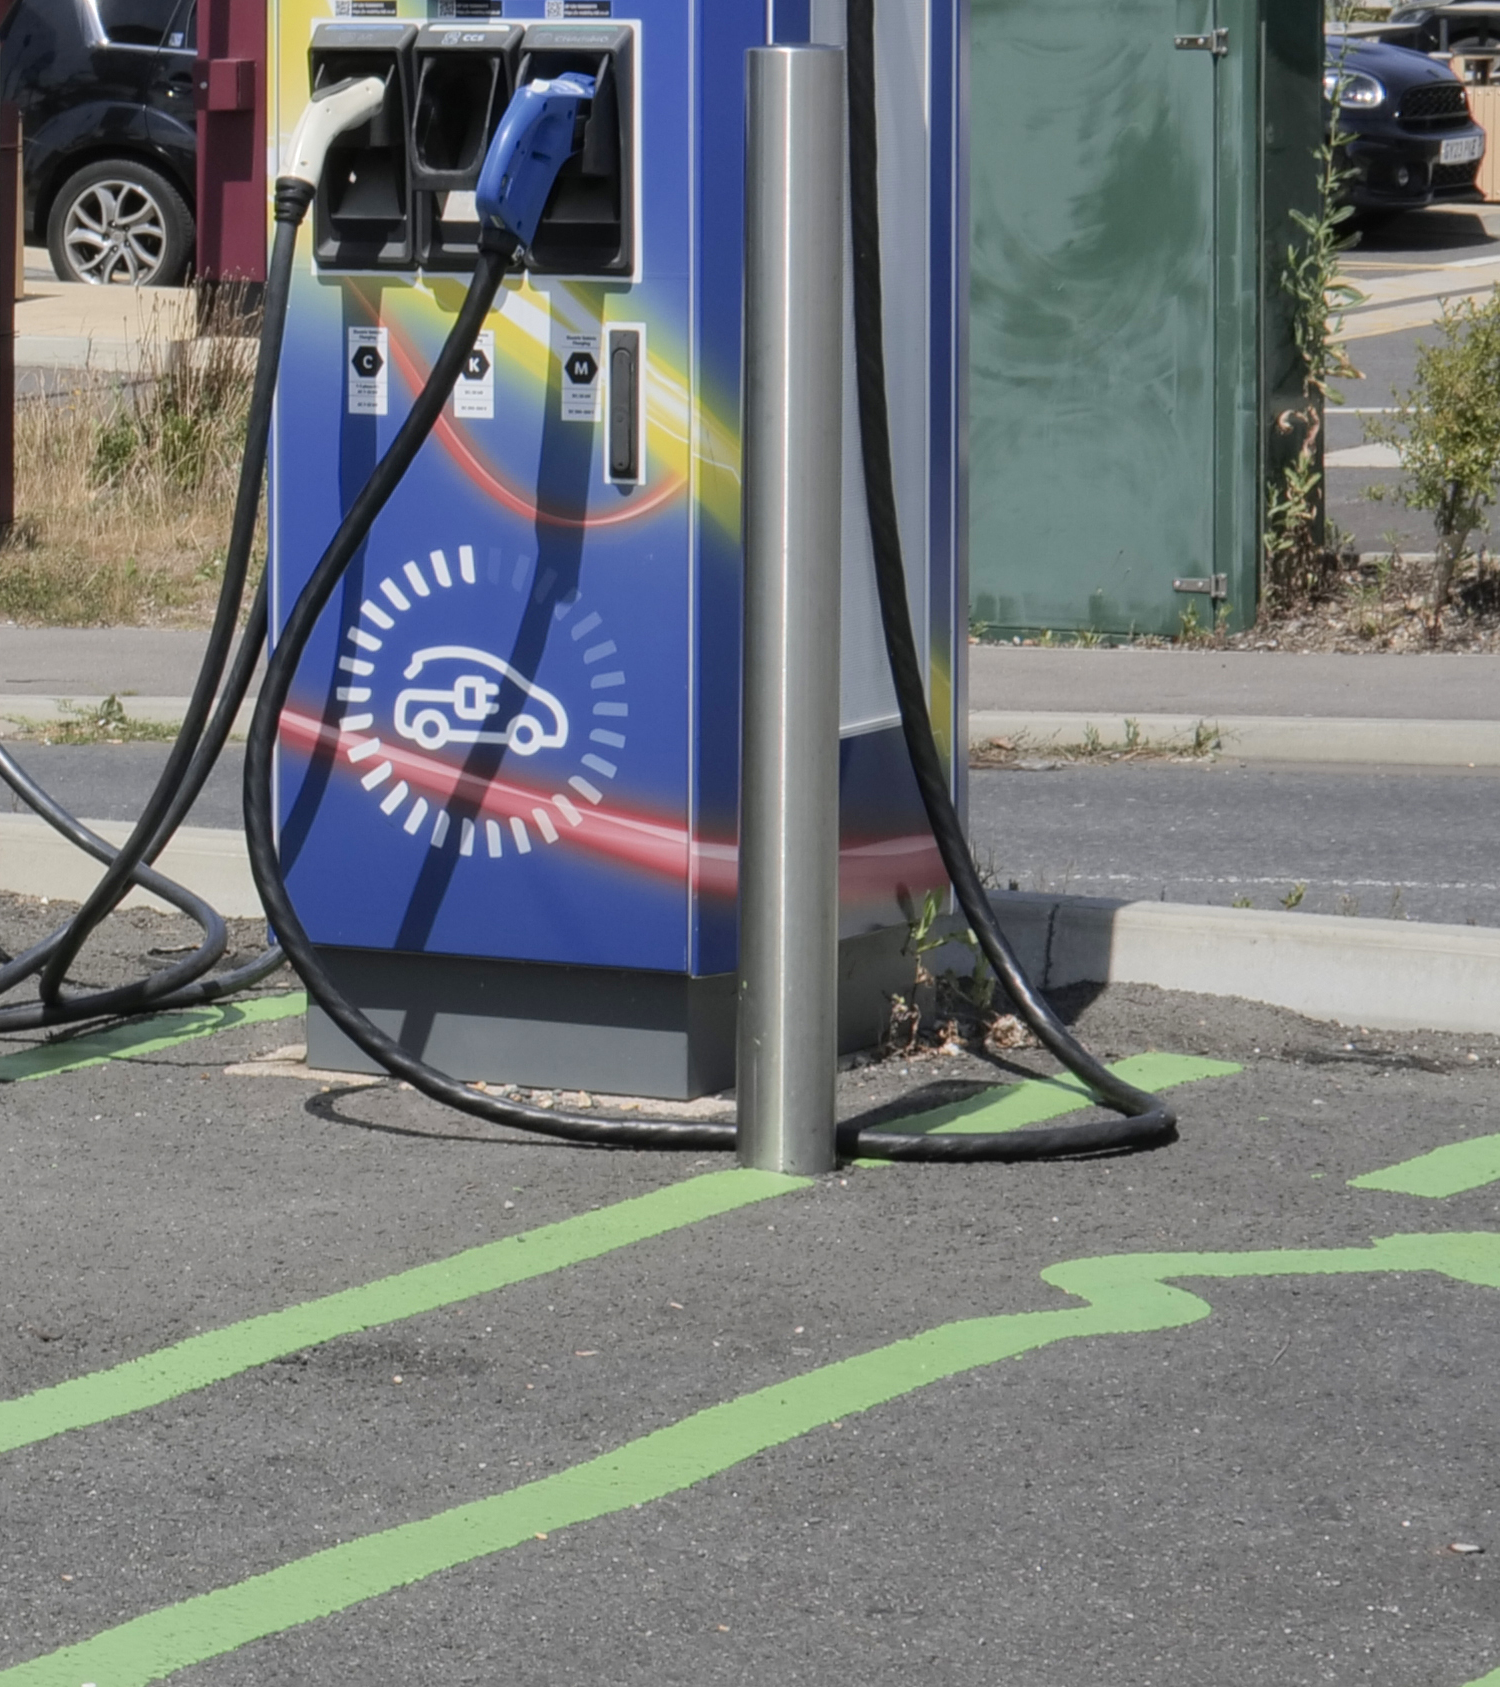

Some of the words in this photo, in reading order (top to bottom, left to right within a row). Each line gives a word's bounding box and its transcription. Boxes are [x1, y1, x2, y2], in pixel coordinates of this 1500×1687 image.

[462, 34, 485, 43] CCS
[362, 355, 373, 369] C
[468, 358, 480, 372] K
[574, 361, 589, 375] M
